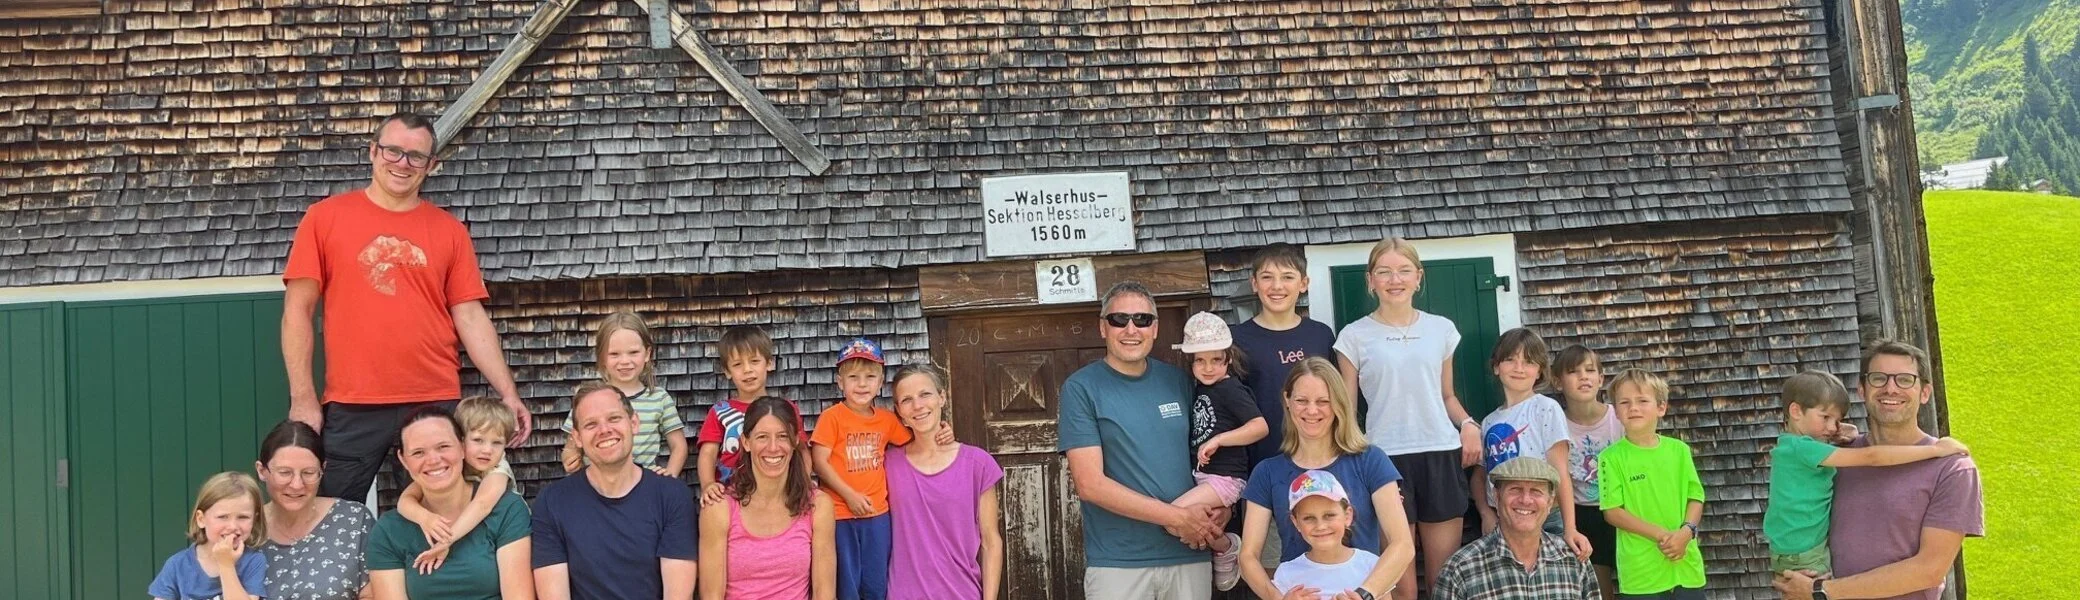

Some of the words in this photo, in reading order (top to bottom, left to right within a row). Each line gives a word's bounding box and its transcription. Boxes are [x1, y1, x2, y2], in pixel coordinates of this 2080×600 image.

[987, 208, 1044, 224] Sektion
[1047, 203, 1126, 222] Hesselberg
[1051, 264, 1080, 287] 28
[957, 327, 980, 347] 20
[1278, 350, 1305, 365] Lee
[1488, 441, 1519, 457] ASA
